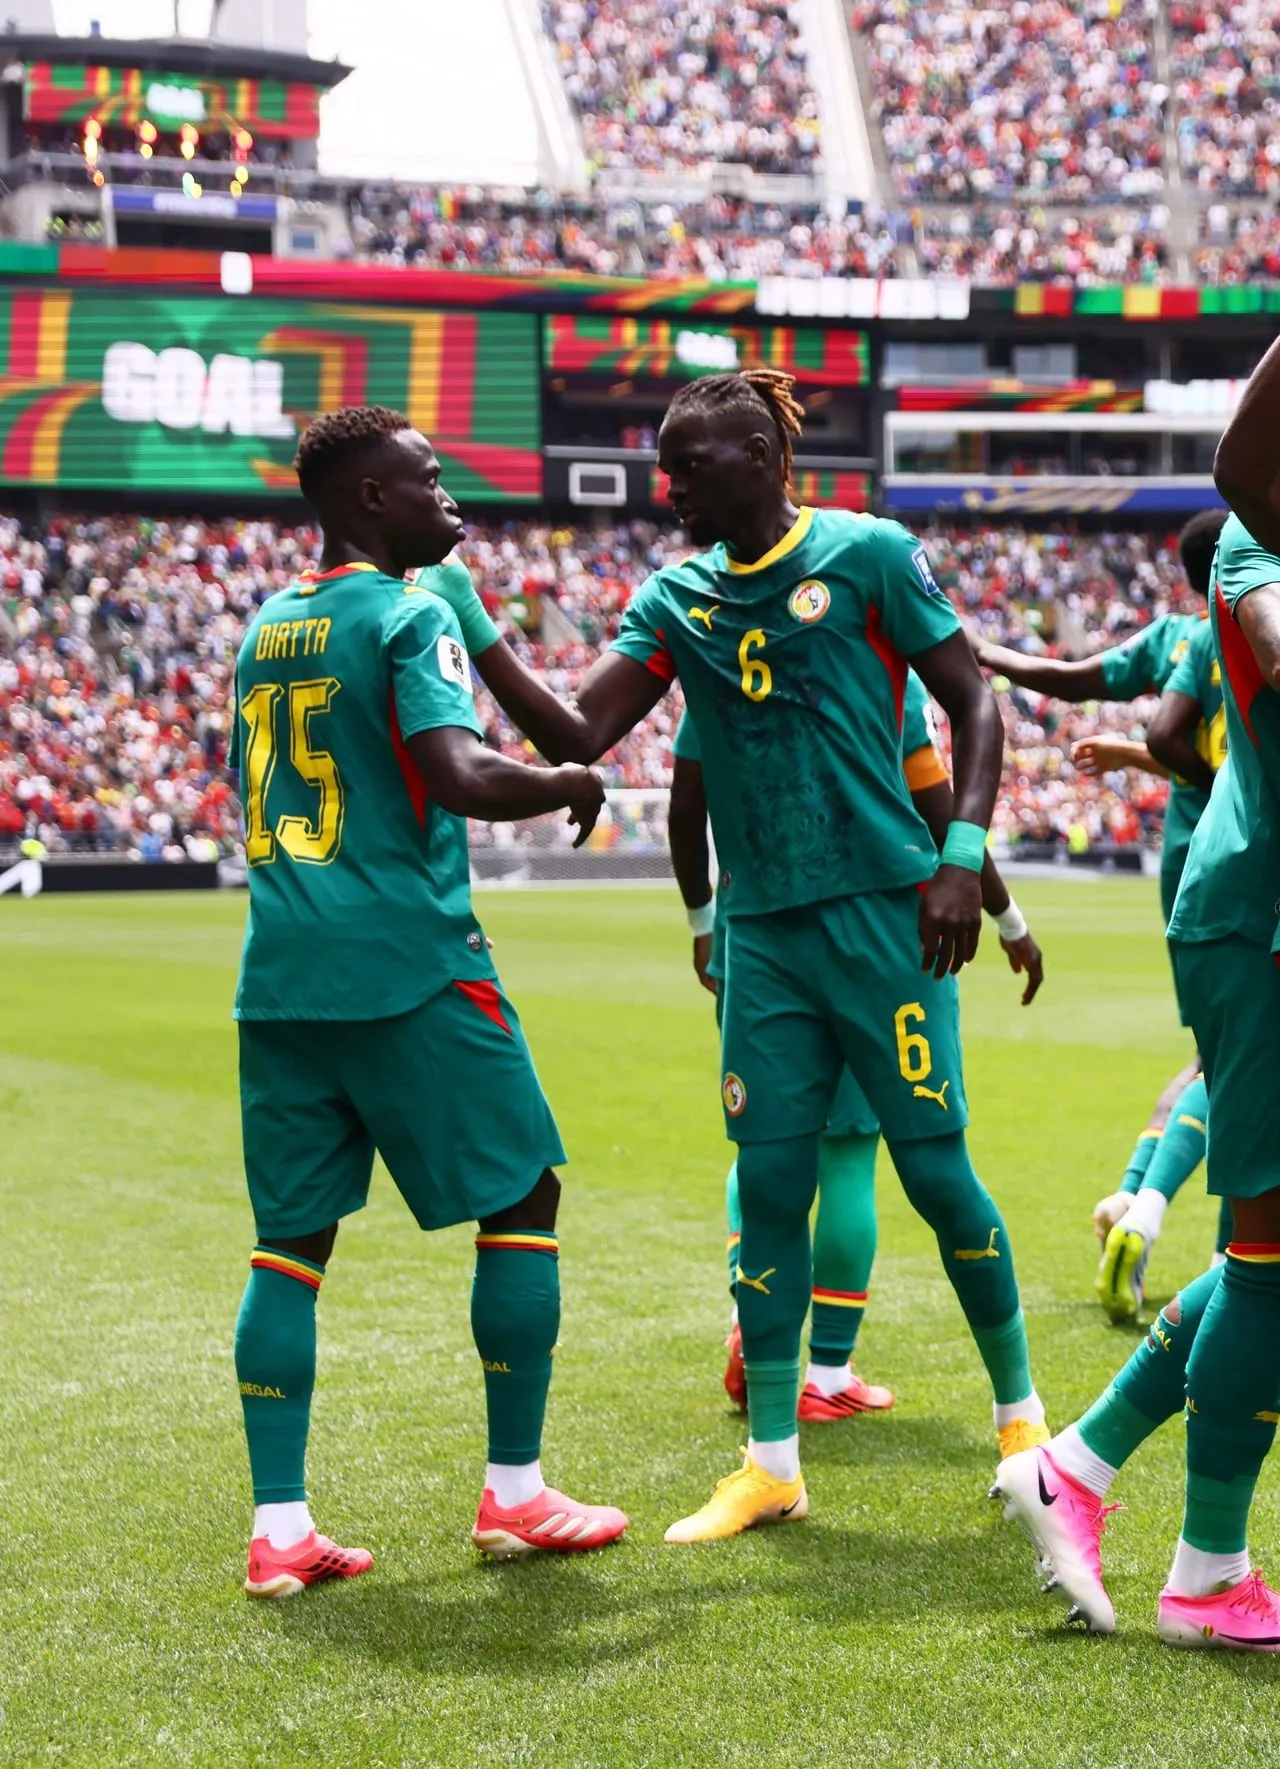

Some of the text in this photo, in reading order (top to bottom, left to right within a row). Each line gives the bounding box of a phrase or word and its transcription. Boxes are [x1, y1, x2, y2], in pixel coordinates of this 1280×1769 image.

[102, 340, 296, 439] GOAL
[255, 617, 331, 661] DIATTA
[738, 628, 772, 702] 6
[241, 677, 342, 867] 15
[894, 1001, 932, 1082] 6
